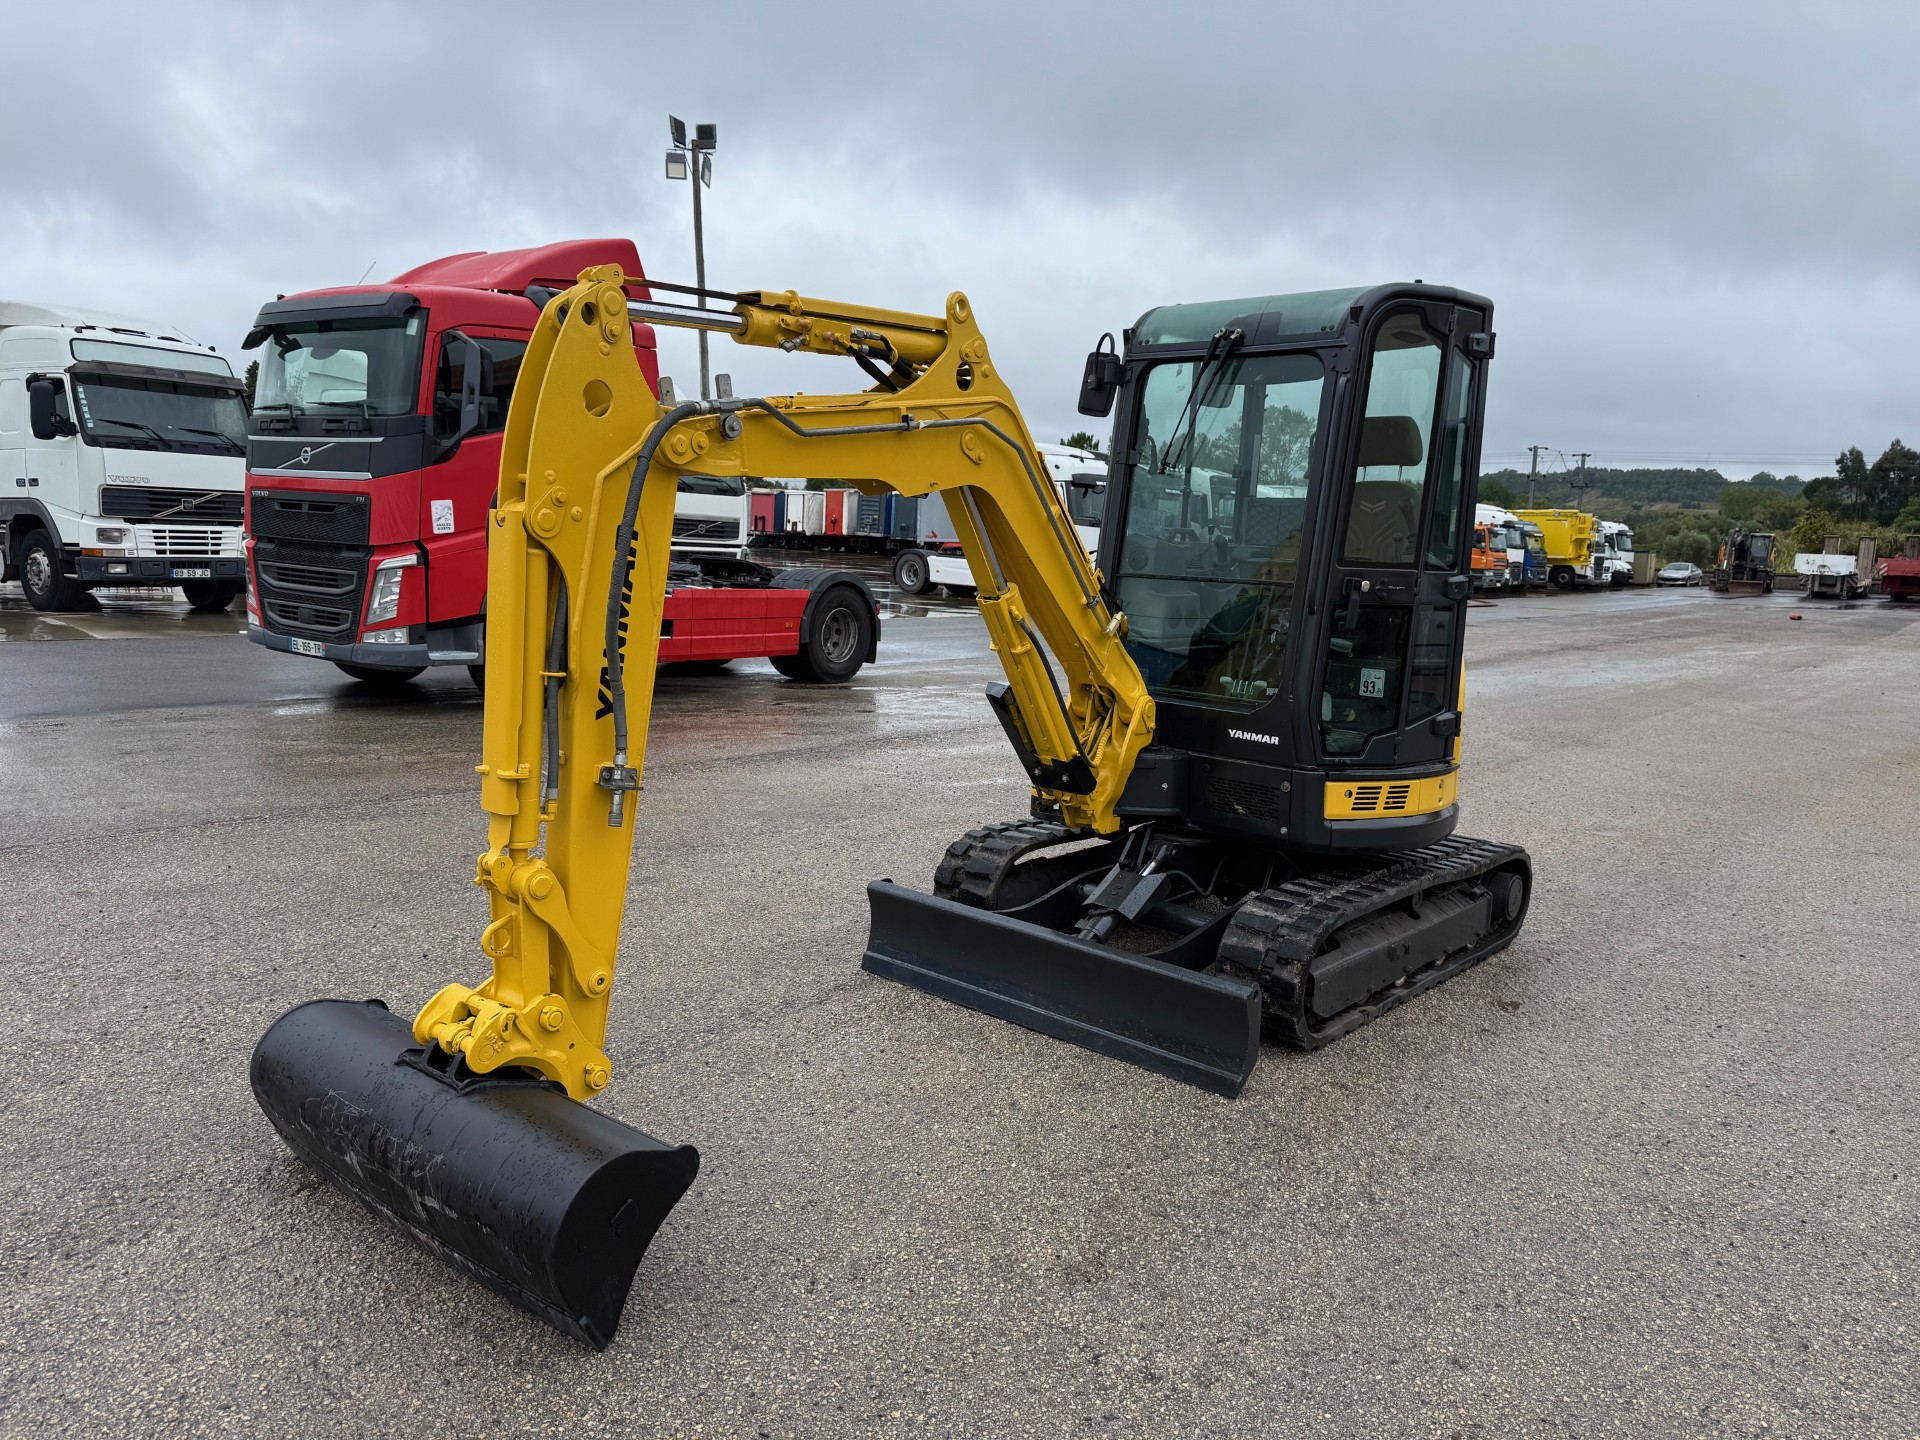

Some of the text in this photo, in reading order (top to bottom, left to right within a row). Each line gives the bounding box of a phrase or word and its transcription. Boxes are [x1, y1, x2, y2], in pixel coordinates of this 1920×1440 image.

[107, 474, 150, 483] VOLVO
[1363, 680, 1376, 694] 93
[1228, 728, 1279, 745] YANMAR
